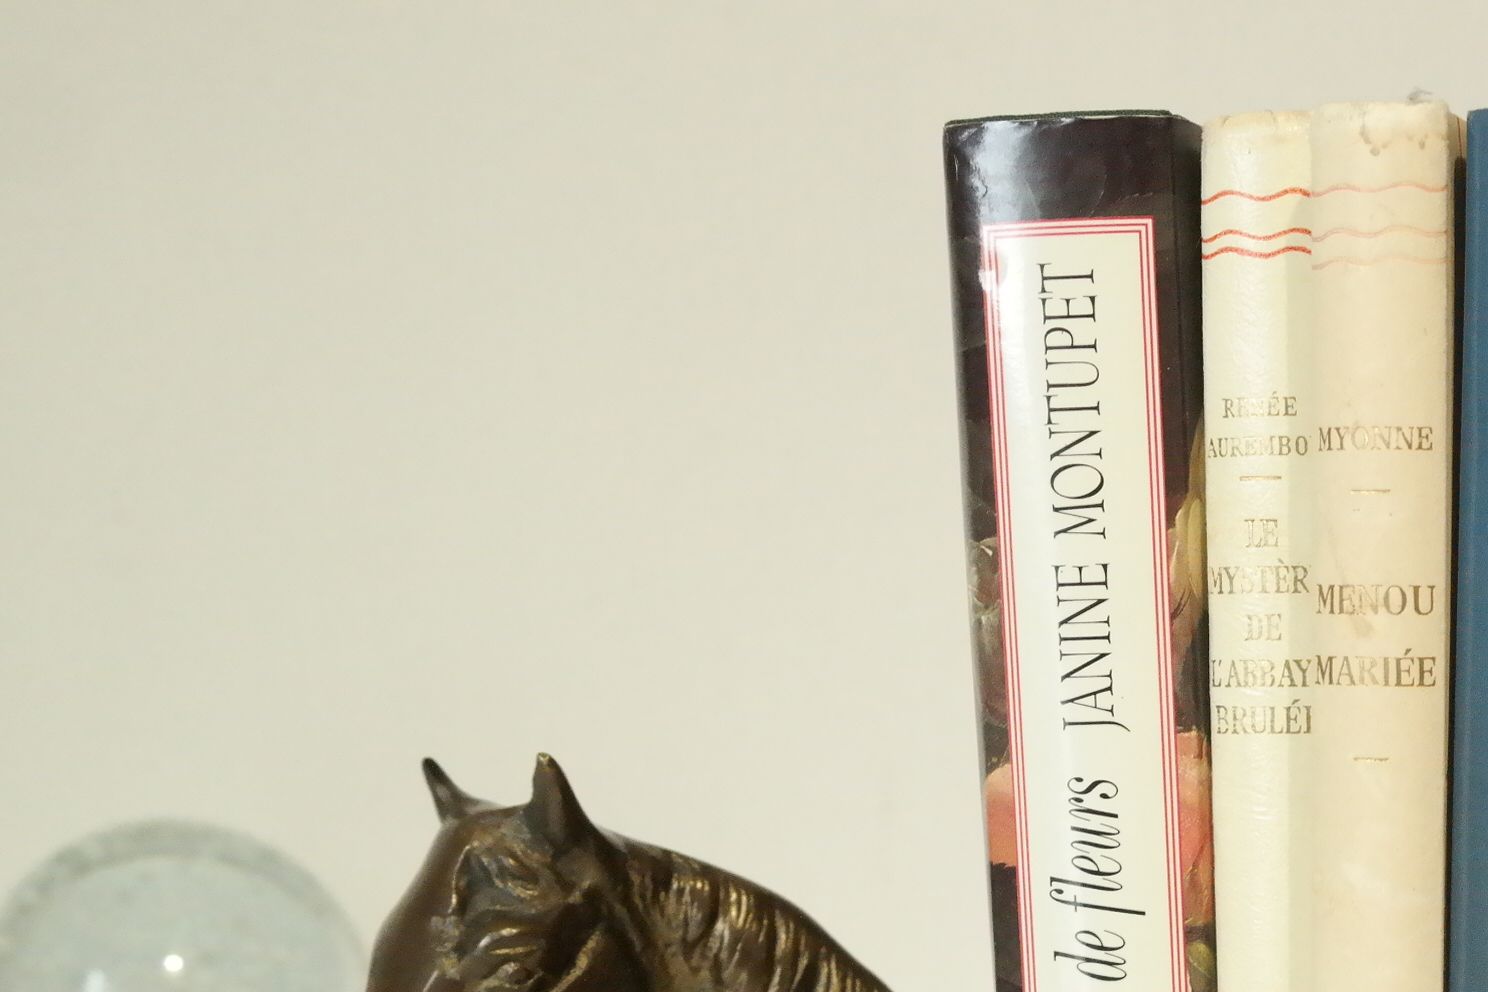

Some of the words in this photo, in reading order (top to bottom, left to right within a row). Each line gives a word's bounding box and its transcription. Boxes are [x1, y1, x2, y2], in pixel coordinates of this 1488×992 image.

[1037, 262, 1107, 540] MONTUPET
[1222, 391, 1298, 419] RENÉE
[1208, 435, 1311, 458] AUREMBO
[1318, 425, 1433, 452] MYONNE
[1244, 518, 1279, 549] LE
[1209, 559, 1311, 595] MYSTÈR
[1316, 583, 1435, 616] MENOU
[1244, 613, 1282, 641] DE
[1053, 563, 1130, 733] JANINE
[1211, 658, 1312, 688] L'ABBAY
[1315, 648, 1436, 688] MARIÉE
[1050, 777, 1145, 915] fleurs
[1054, 930, 1126, 981] de
